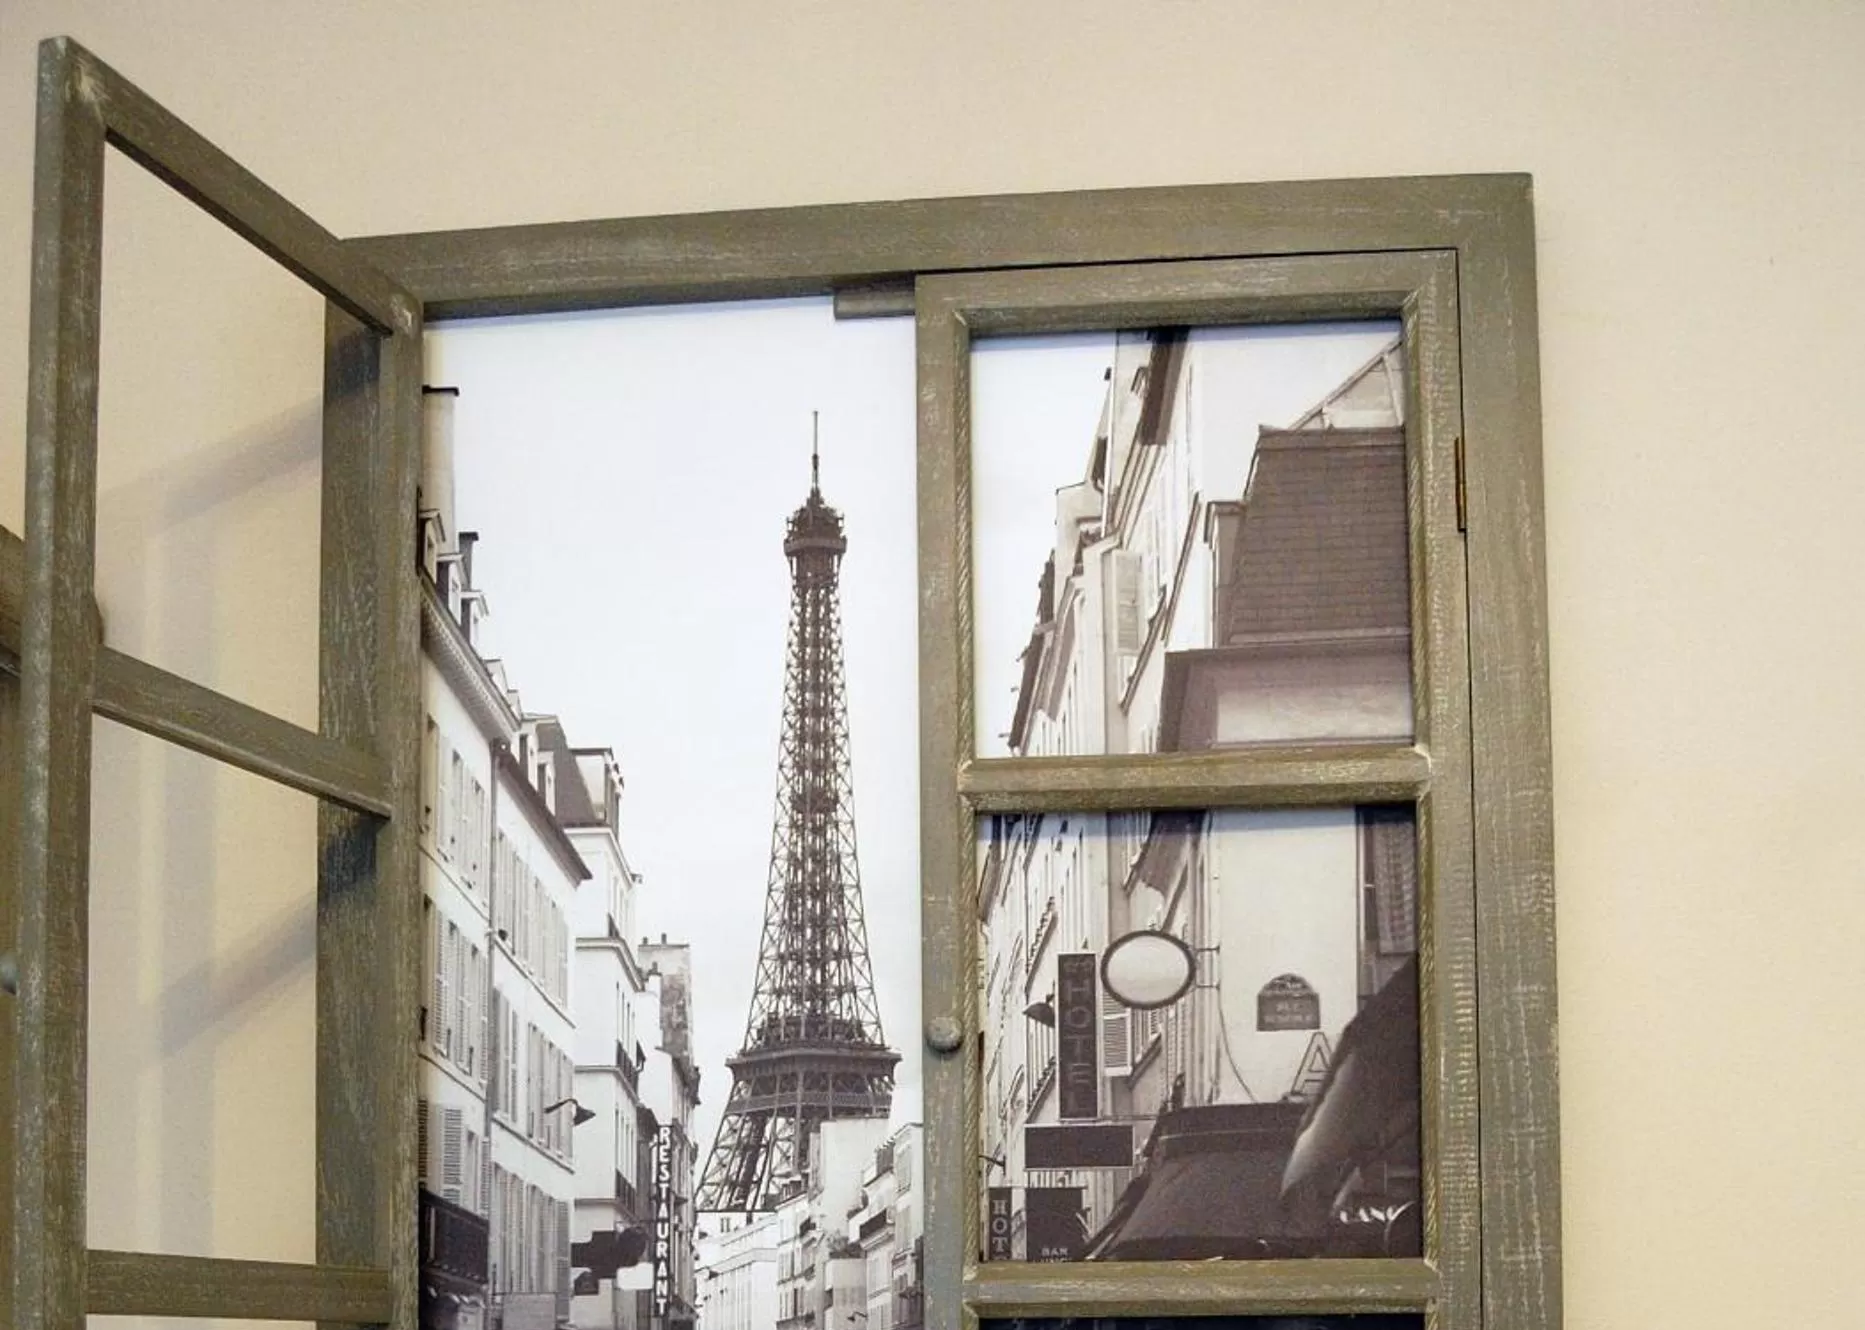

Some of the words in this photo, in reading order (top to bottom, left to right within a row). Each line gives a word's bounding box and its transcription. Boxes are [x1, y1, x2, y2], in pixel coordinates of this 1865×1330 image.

[1064, 979, 1093, 1114] HOTEL
[656, 1126, 671, 1316] RESTAURANT
[992, 1200, 1008, 1259] HOT
